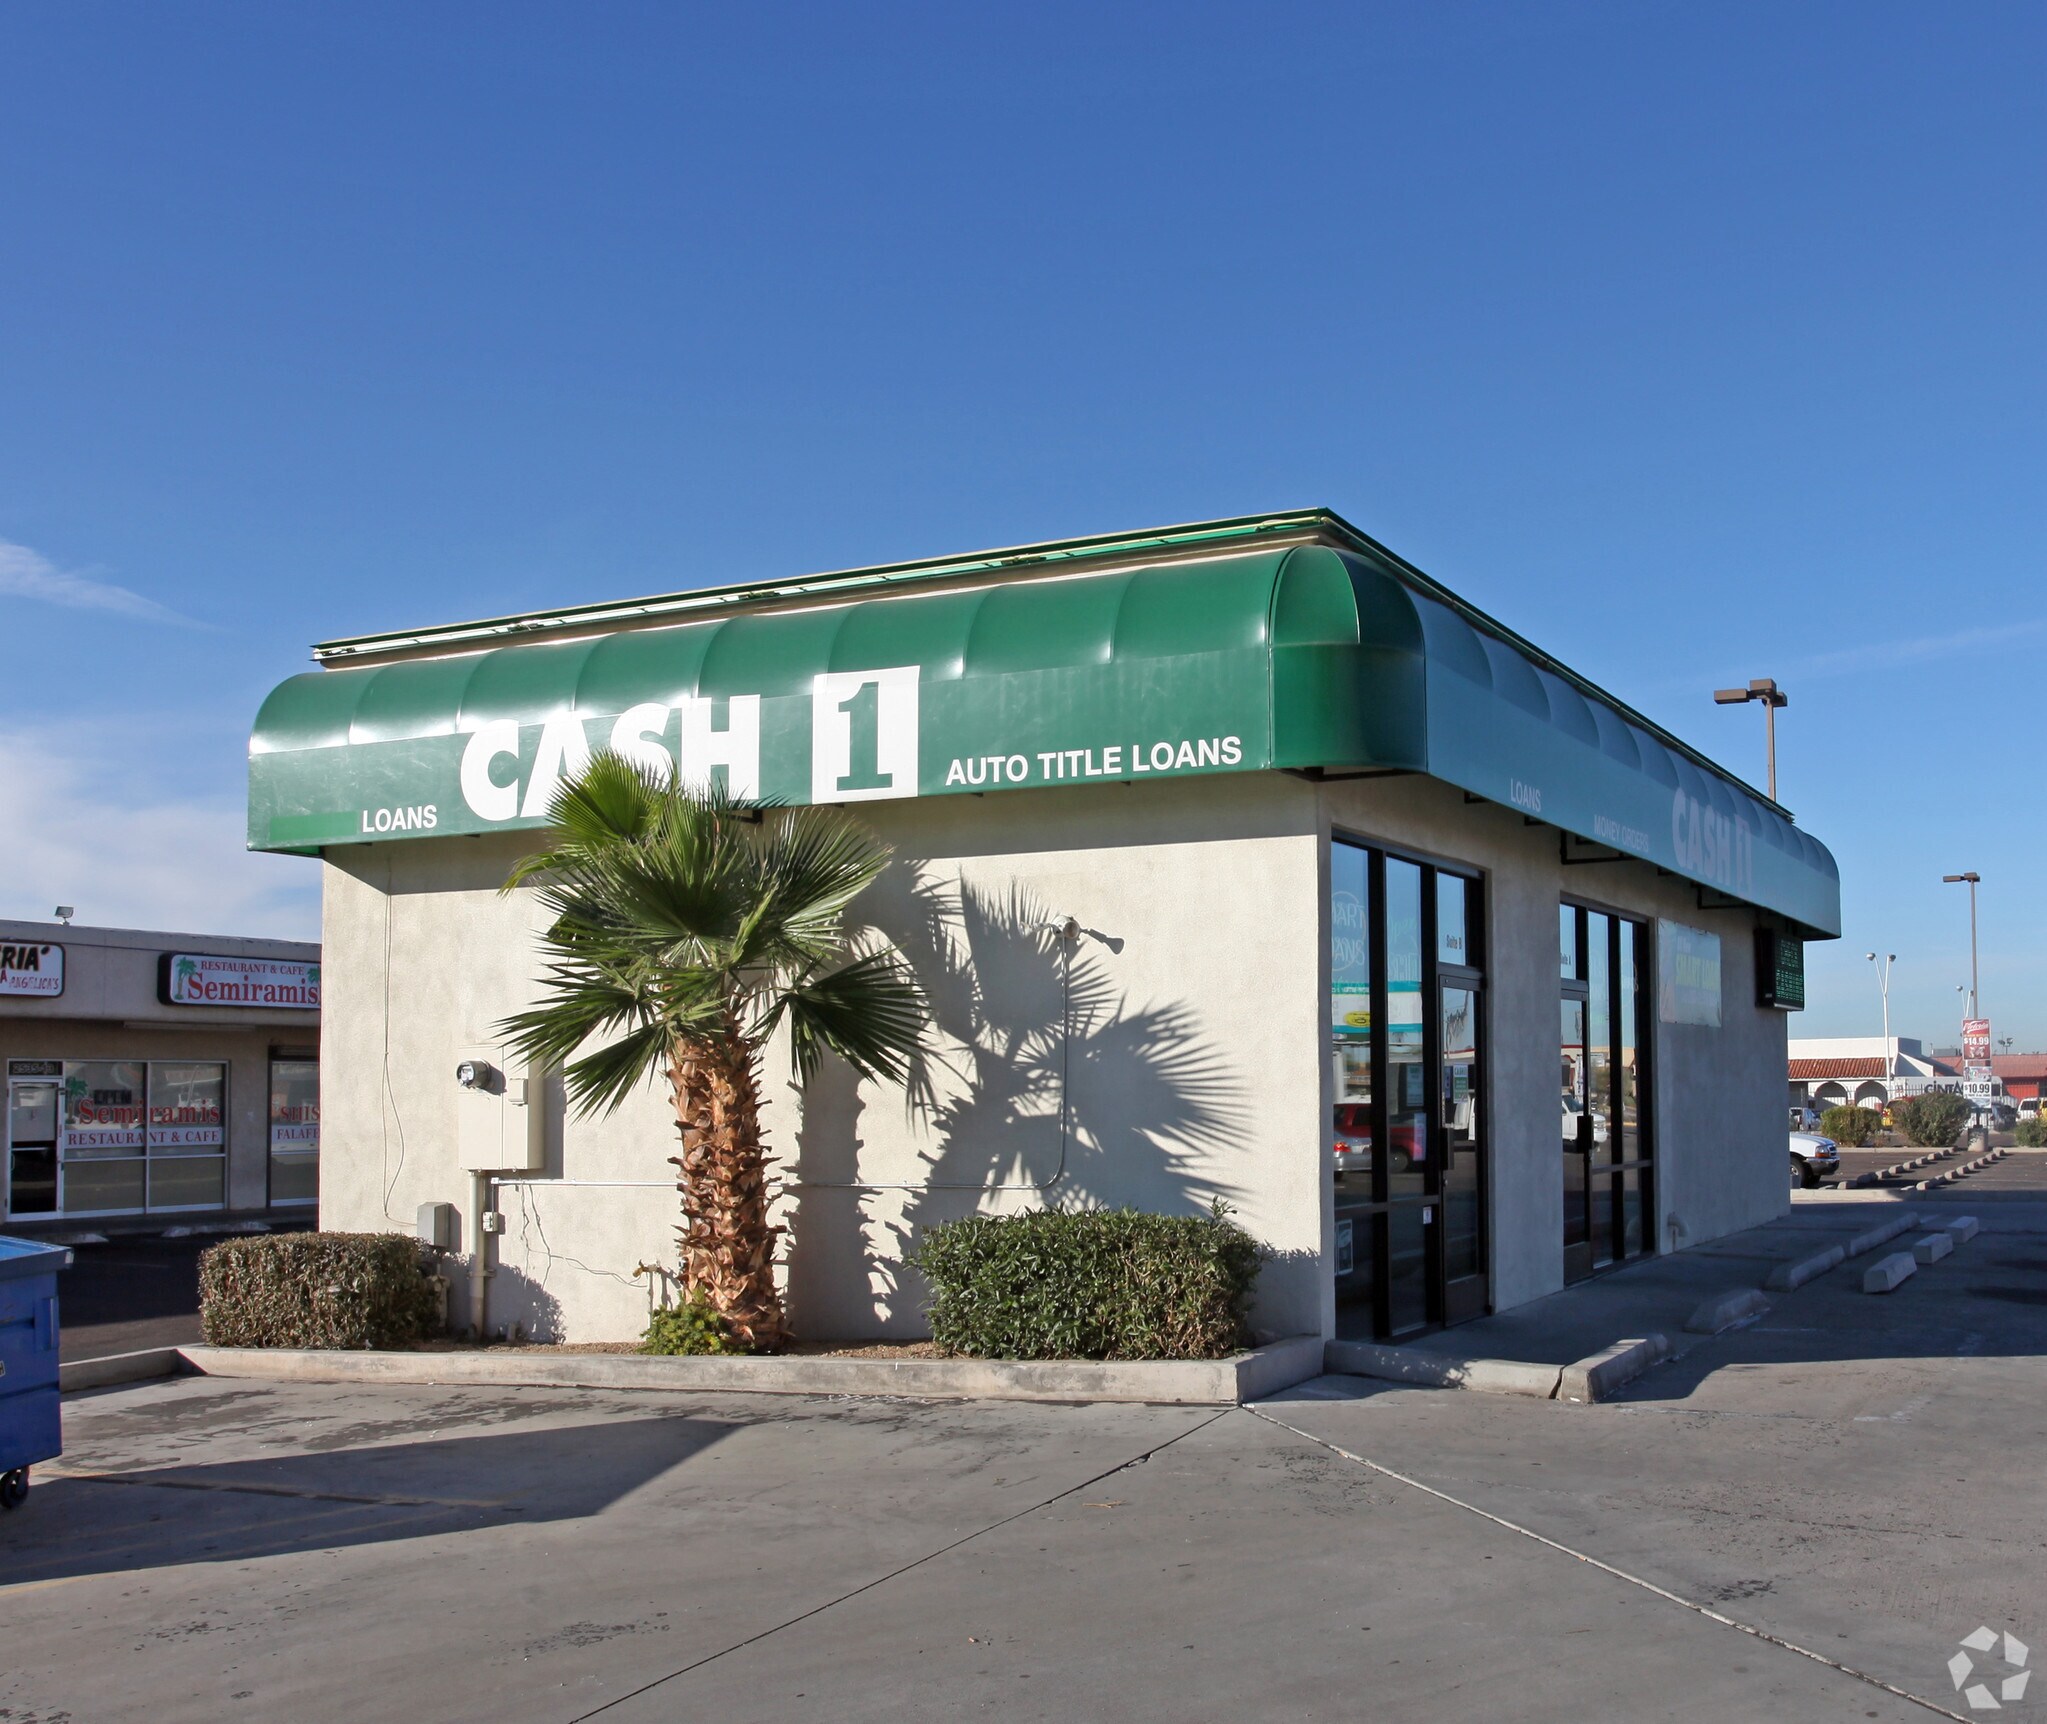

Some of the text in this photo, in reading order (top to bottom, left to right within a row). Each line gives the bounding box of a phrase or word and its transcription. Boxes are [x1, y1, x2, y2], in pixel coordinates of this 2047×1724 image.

[460, 695, 761, 821] CASH
[945, 736, 1243, 786] AUTO TITLE LOANS
[1510, 778, 1541, 812] LOANS
[361, 804, 438, 833] LOANS
[1593, 815, 1649, 852] MONEY ORDERS
[1672, 787, 1731, 886] CASH
[201, 960, 267, 974] RESTAURANT
[270, 965, 277, 975] &
[187, 972, 319, 1005] Semiramis
[1964, 1037, 1989, 1046] $14.99
[1964, 1083, 1990, 1094] $10.99
[79, 1097, 221, 1125] Semiramis
[68, 1131, 166, 1146] RESTAURANT
[171, 1131, 180, 1143] &
